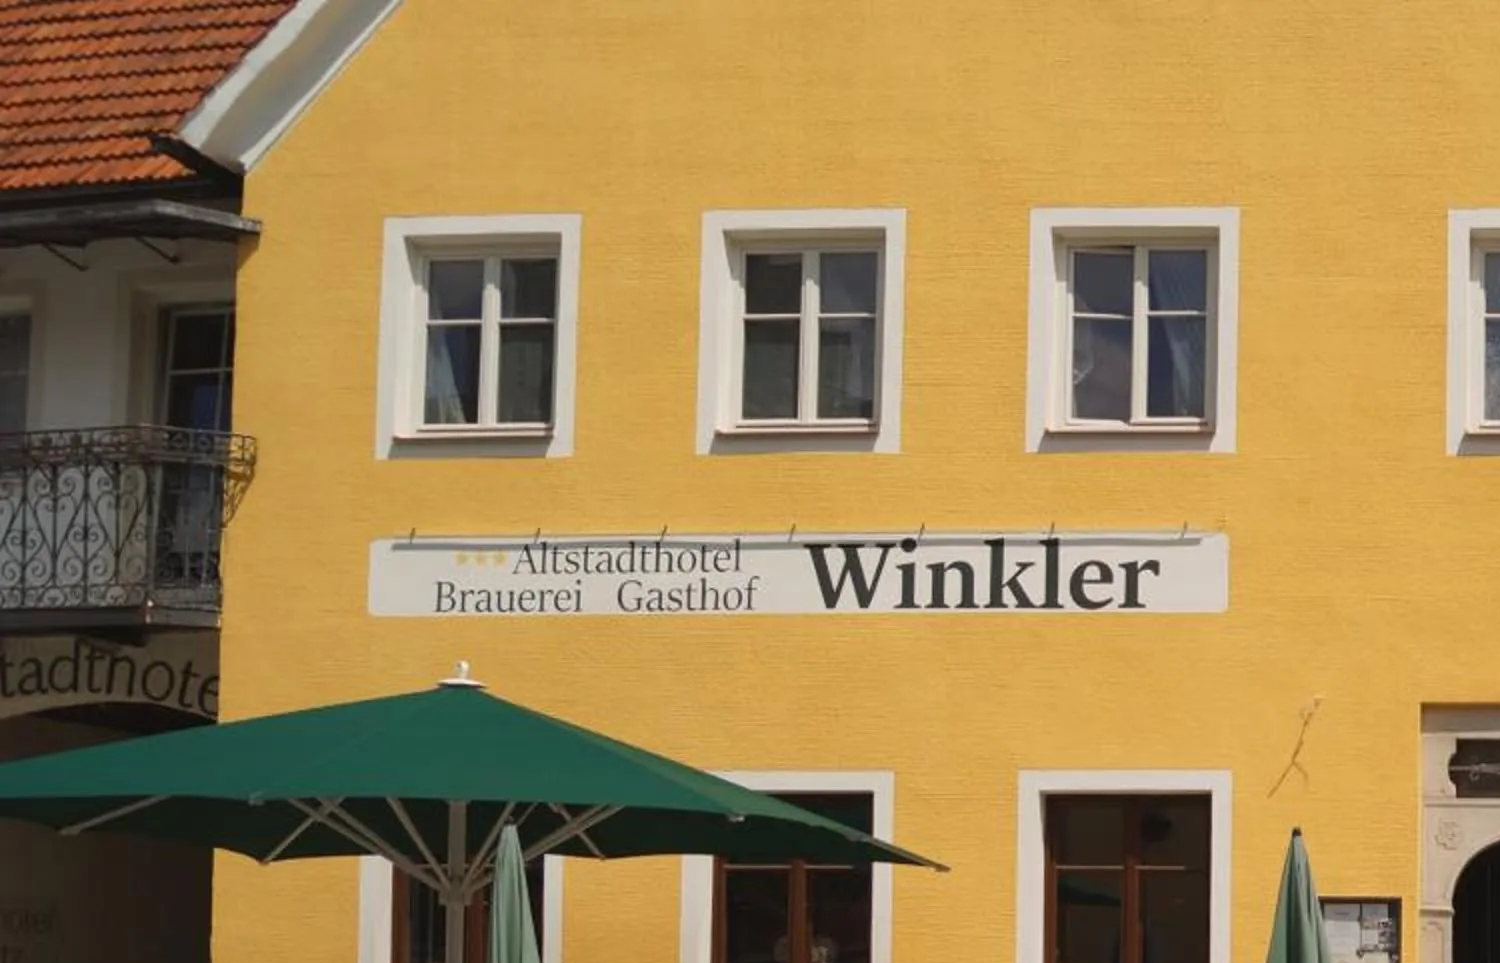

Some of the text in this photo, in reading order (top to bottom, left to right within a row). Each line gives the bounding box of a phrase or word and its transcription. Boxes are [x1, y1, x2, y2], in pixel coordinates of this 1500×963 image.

[512, 539, 741, 575] Altstadthotel
[803, 537, 1160, 610] Winkler
[434, 575, 760, 613] Brauerei Gasthof
[0, 637, 219, 716] tadthote
